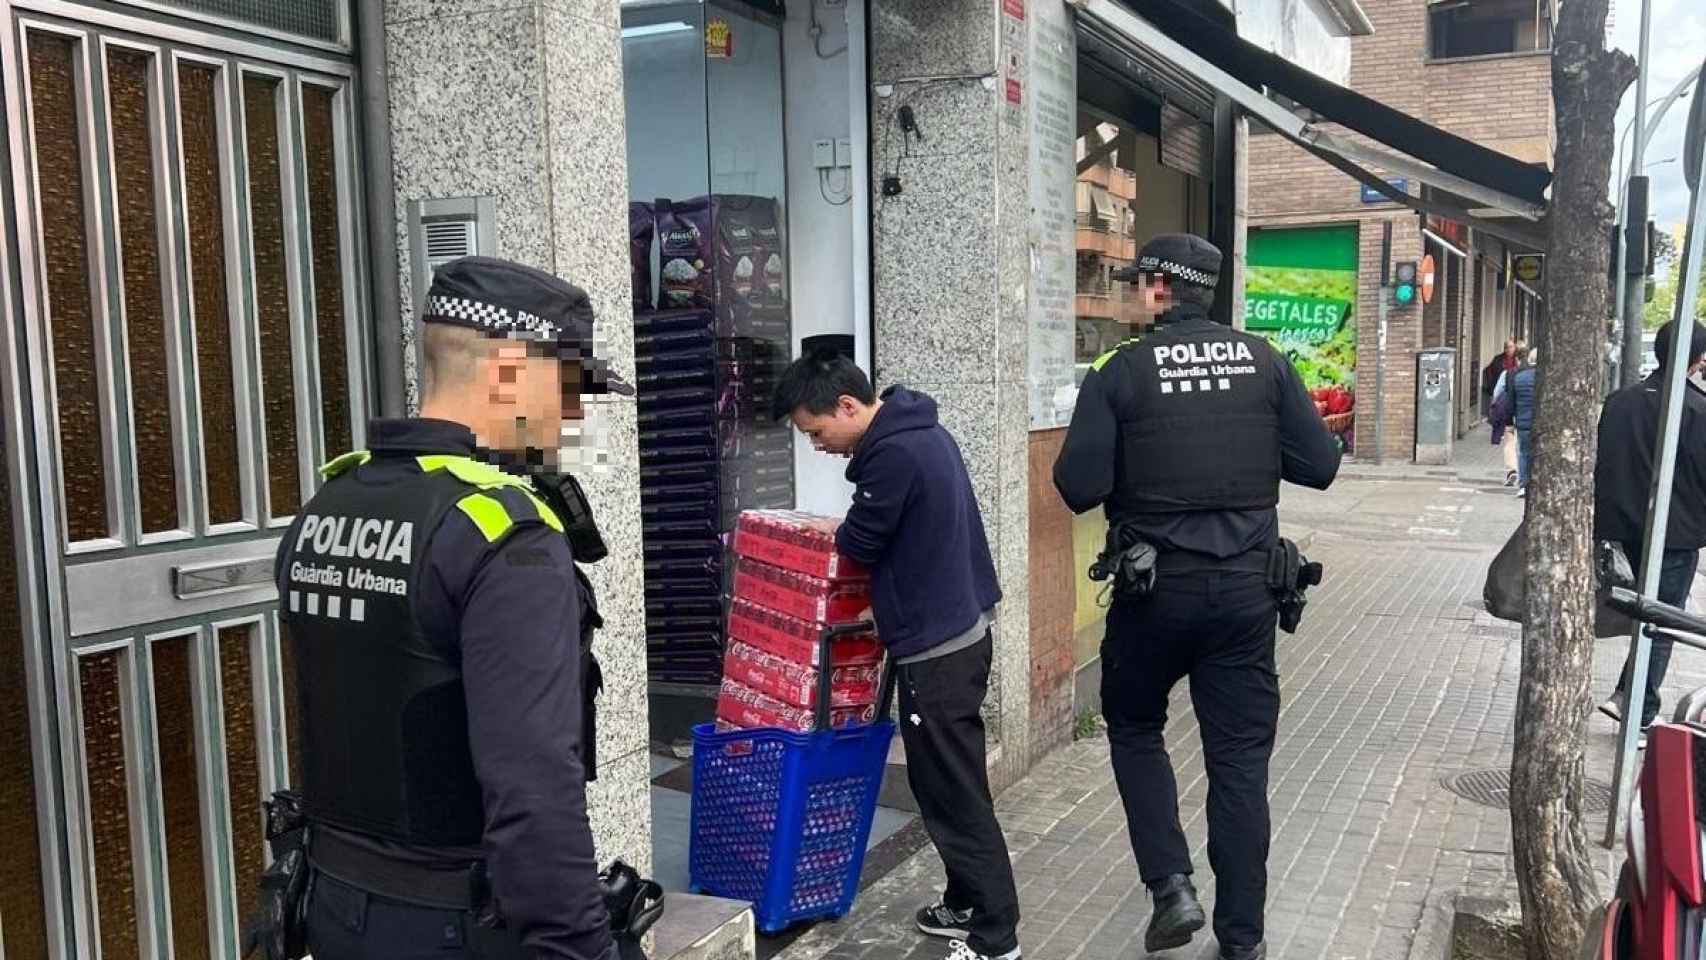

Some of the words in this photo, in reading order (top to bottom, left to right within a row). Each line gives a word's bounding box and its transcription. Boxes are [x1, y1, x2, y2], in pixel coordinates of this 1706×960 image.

[1244, 298, 1337, 325] EGETALES
[1153, 342, 1254, 365] POLICIA
[1159, 367, 1208, 378] Guàrdia
[1211, 364, 1256, 375] Urbana
[295, 514, 413, 564] POLICIA
[290, 561, 343, 587] Guàrdia
[347, 567, 407, 596] Urbana
